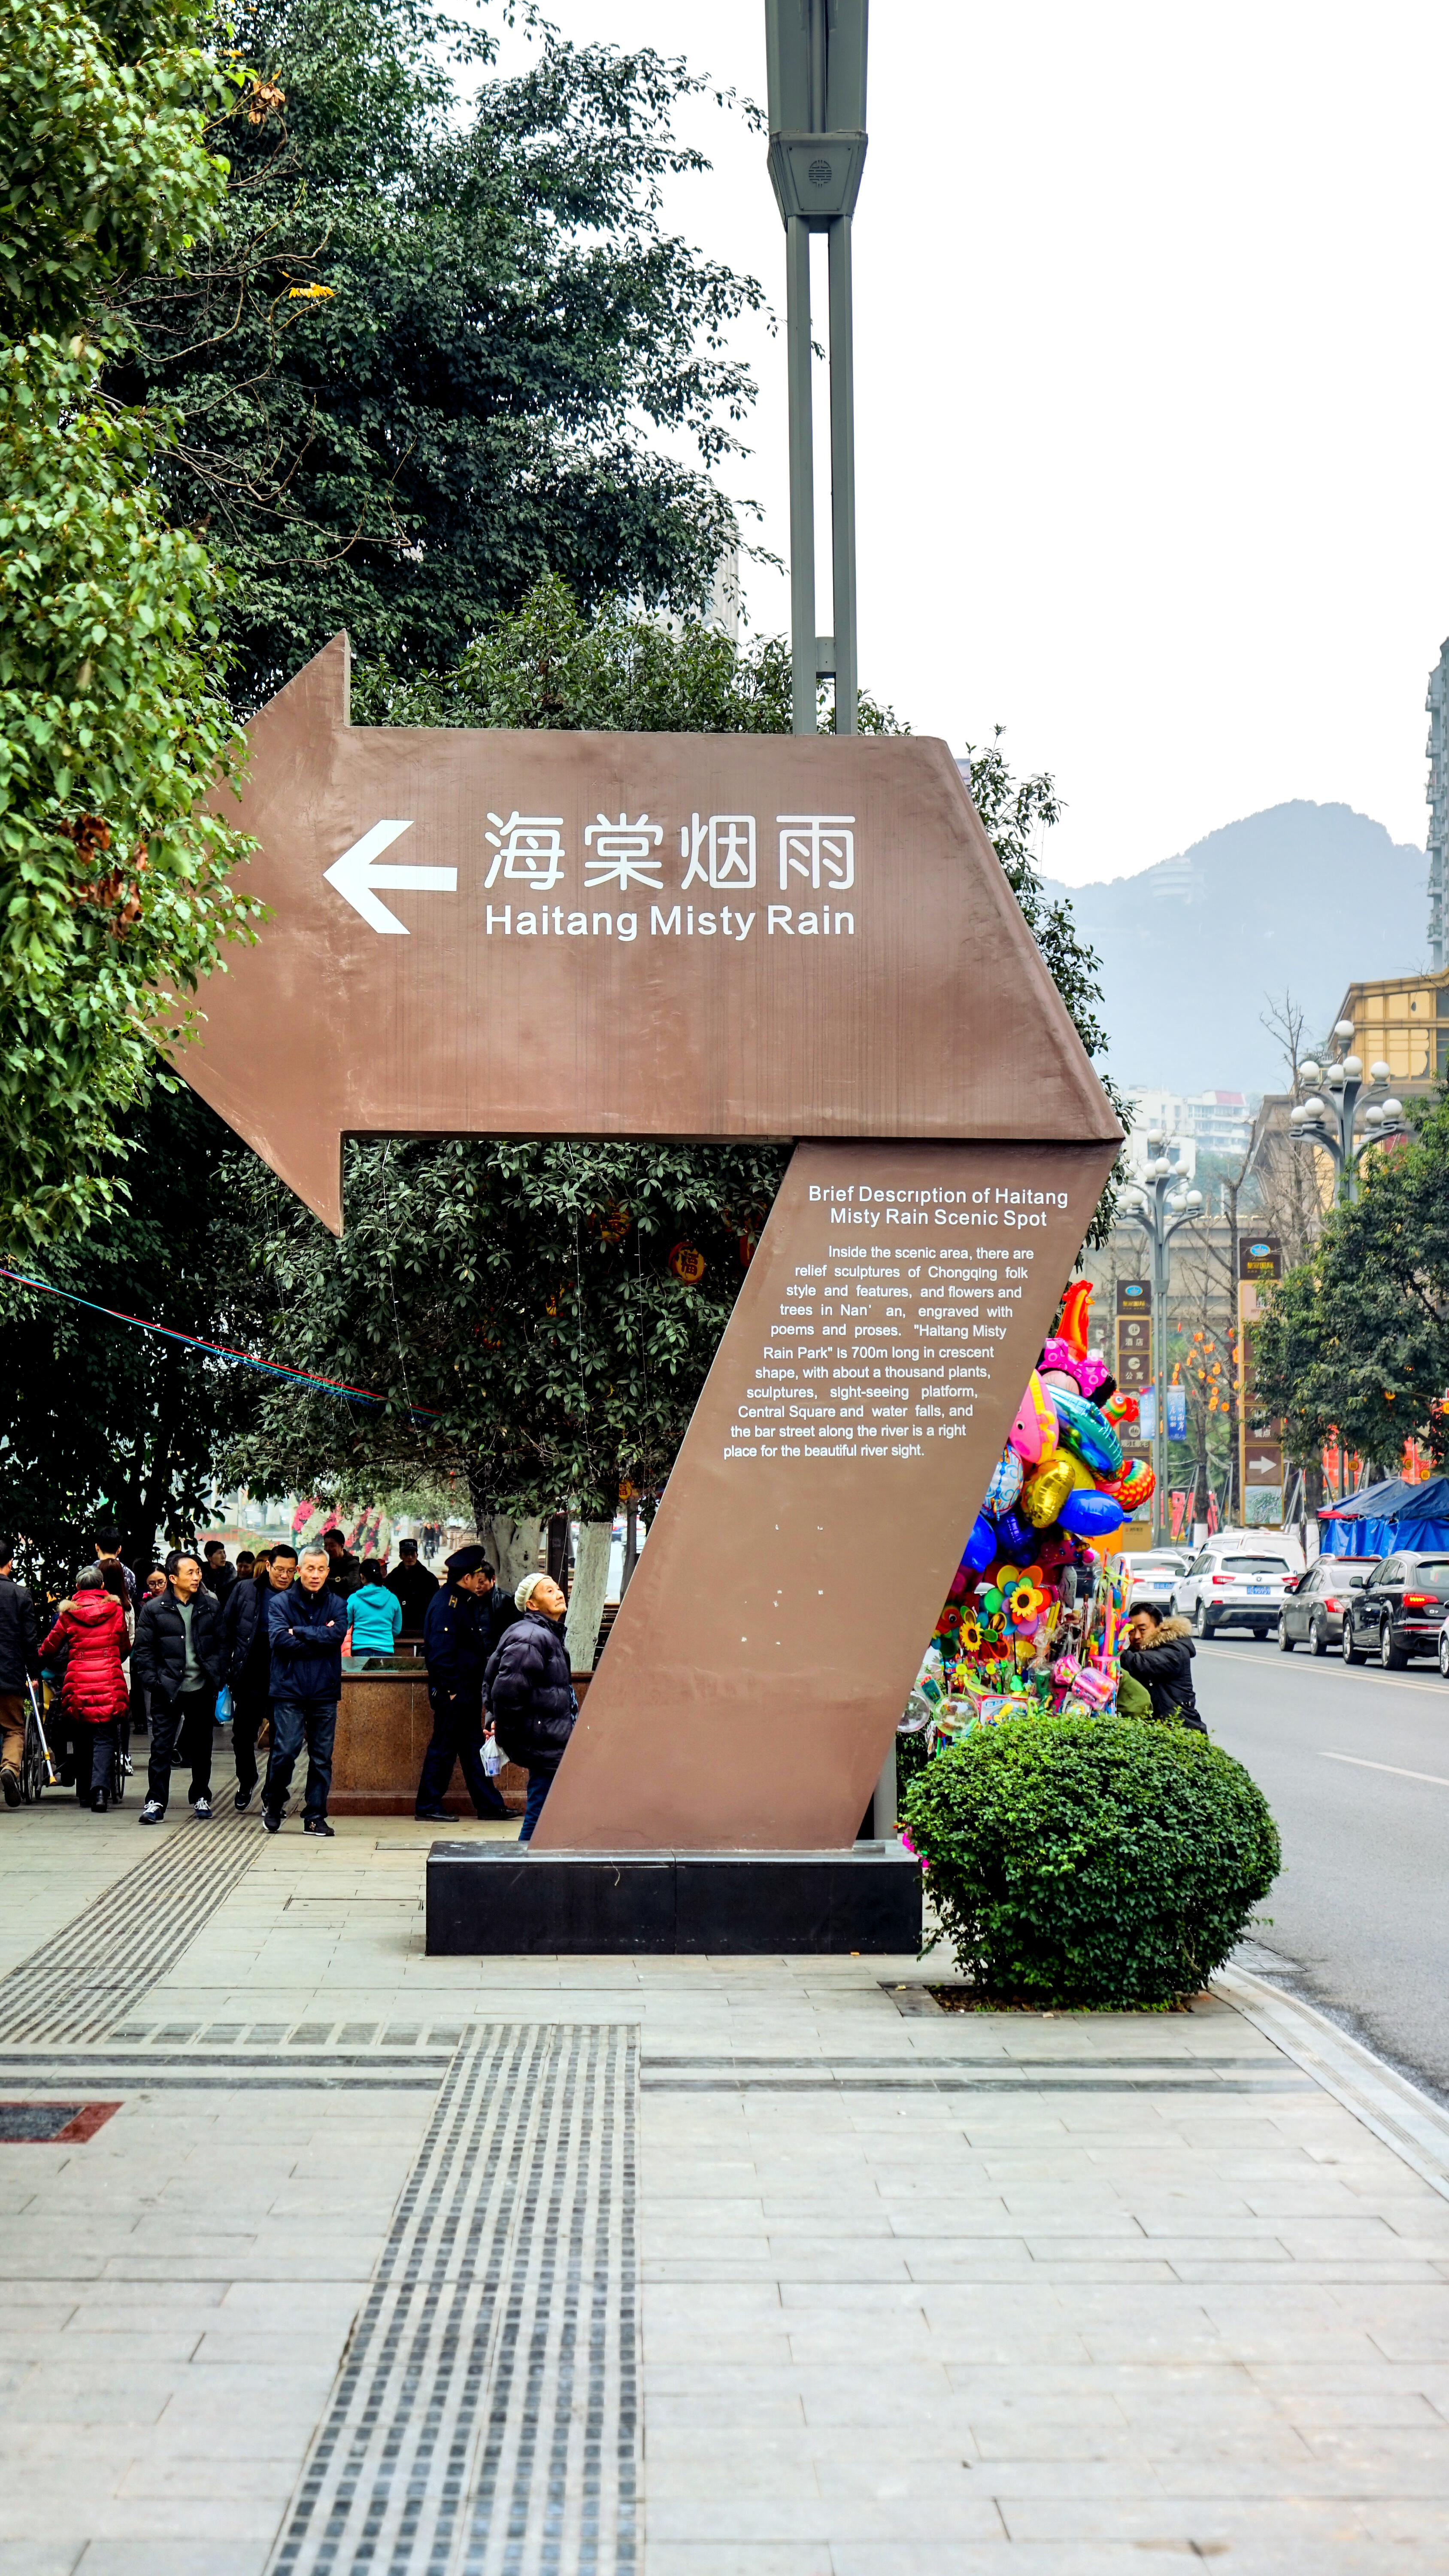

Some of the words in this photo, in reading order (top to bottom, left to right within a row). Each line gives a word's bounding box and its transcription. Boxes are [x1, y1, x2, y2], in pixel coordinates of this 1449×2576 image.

[484, 811, 855, 891] 海棠烟雨
[486, 905, 637, 942] Haitang
[651, 905, 756, 941] Misty
[768, 905, 854, 935] Rain
[809, 1185, 855, 1202] Brief
[859, 1186, 966, 1206] Description
[972, 1188, 991, 1203] of
[995, 1188, 1068, 1209] Haitang
[831, 1207, 880, 1228] Misty
[886, 1208, 928, 1224] Rain
[934, 1209, 998, 1226] Scenic
[1003, 1210, 1047, 1230] Spot
[829, 1245, 867, 1258] Inside
[870, 1246, 891, 1258] the
[894, 1247, 936, 1259] scenic
[940, 1249, 973, 1261] area,
[976, 1247, 1009, 1259] there
[1013, 1250, 1034, 1259] are
[795, 1264, 828, 1277] relief
[834, 1265, 900, 1280] sculptures
[908, 1265, 921, 1278] of
[928, 1266, 997, 1282] Chongqing
[1005, 1266, 1028, 1279] folk
[786, 1284, 816, 1299] style
[824, 1284, 848, 1297] and
[856, 1284, 912, 1299] features,
[920, 1285, 944, 1298] and
[948, 1285, 994, 1298] flowers
[998, 1286, 1022, 1298] and
[779, 1303, 813, 1315] trees
[821, 1303, 833, 1316] in
[886, 1307, 906, 1318] an,
[918, 1305, 979, 1320] engraved
[986, 1306, 1013, 1318] with
[771, 1325, 814, 1337] poems
[822, 1323, 846, 1336] and
[855, 1326, 901, 1339] proses.
[914, 1324, 969, 1340] "Haitang
[973, 1324, 1007, 1340] Misty
[1125, 1338, 1144, 1346] 酒店
[764, 1346, 793, 1359] Rain
[798, 1346, 833, 1359] Park"
[837, 1347, 848, 1358] is
[851, 1346, 888, 1358] 700m
[892, 1346, 919, 1361] long
[924, 1346, 934, 1358] in
[939, 1346, 994, 1358] crescent
[755, 1366, 798, 1382] shape,
[802, 1366, 828, 1378] with
[833, 1366, 870, 1378] about
[873, 1368, 881, 1378] a
[885, 1365, 944, 1378] thousand
[949, 1365, 991, 1380] plants,
[746, 1386, 818, 1401] sculptures,
[830, 1385, 909, 1401] sight-seeing
[921, 1385, 978, 1400] platform,
[738, 1405, 785, 1418] Central
[789, 1405, 836, 1420] Square
[840, 1405, 864, 1417] and
[871, 1405, 908, 1417] water
[915, 1404, 945, 1418] falls,
[949, 1404, 973, 1416] and
[730, 1425, 751, 1438] the
[755, 1425, 776, 1437] bar
[779, 1425, 815, 1437] street
[818, 1425, 853, 1440] along
[857, 1424, 877, 1437] the
[881, 1424, 909, 1437] river
[912, 1424, 923, 1436] is
[926, 1427, 934, 1436] a
[938, 1424, 967, 1439] right
[724, 1445, 757, 1460] place
[760, 1444, 778, 1457] for
[780, 1444, 801, 1457] the
[804, 1444, 857, 1457] beautiful
[861, 1444, 888, 1456] river
[891, 1443, 925, 1459] sight.
